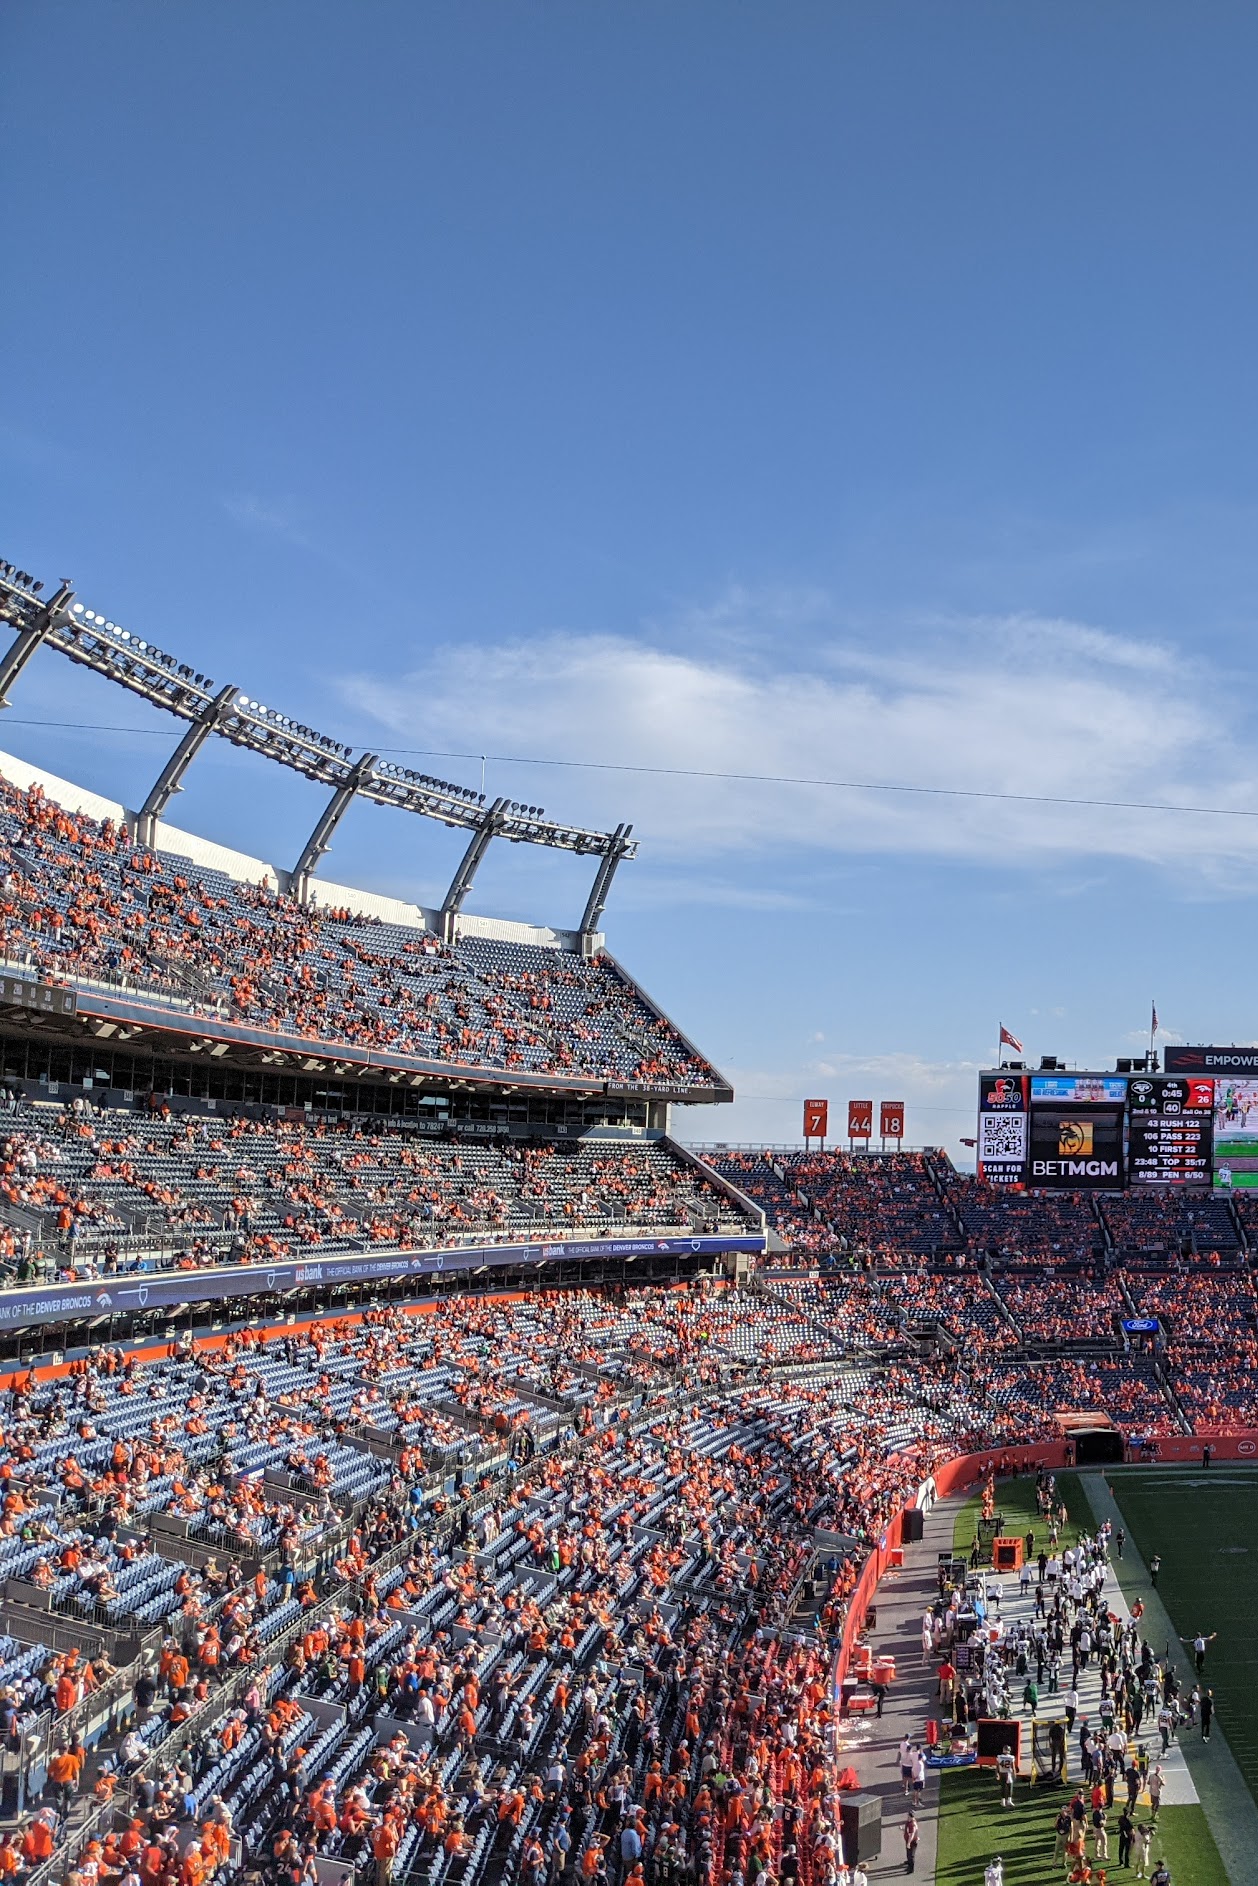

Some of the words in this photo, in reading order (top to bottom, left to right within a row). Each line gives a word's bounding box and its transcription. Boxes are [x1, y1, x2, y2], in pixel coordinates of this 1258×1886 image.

[987, 1092, 1021, 1103] 5050
[1162, 1090, 1182, 1098] 0:45
[1197, 1096, 1210, 1104] 26
[1166, 1104, 1178, 1112] 40
[306, 1113, 314, 1122] Fan
[427, 1122, 444, 1130] 78247
[464, 1124, 474, 1132] call
[811, 1116, 821, 1131] 7
[850, 1117, 871, 1132] 44
[884, 1117, 900, 1133] 18
[1033, 1161, 1118, 1176] BETMGM
[327, 1268, 335, 1276] THE
[335, 1266, 351, 1276] OFFICIAL
[352, 1265, 362, 1274] BANK
[363, 1264, 369, 1273] OF
[12, 1305, 22, 1318] OF
[22, 1303, 35, 1315] THE
[36, 1300, 61, 1314] DENVER
[62, 1296, 91, 1310] BRONCOS
[205, 1646, 217, 1656] 58
[1000, 1760, 1011, 1768] 42
[277, 1863, 291, 1874] 24
